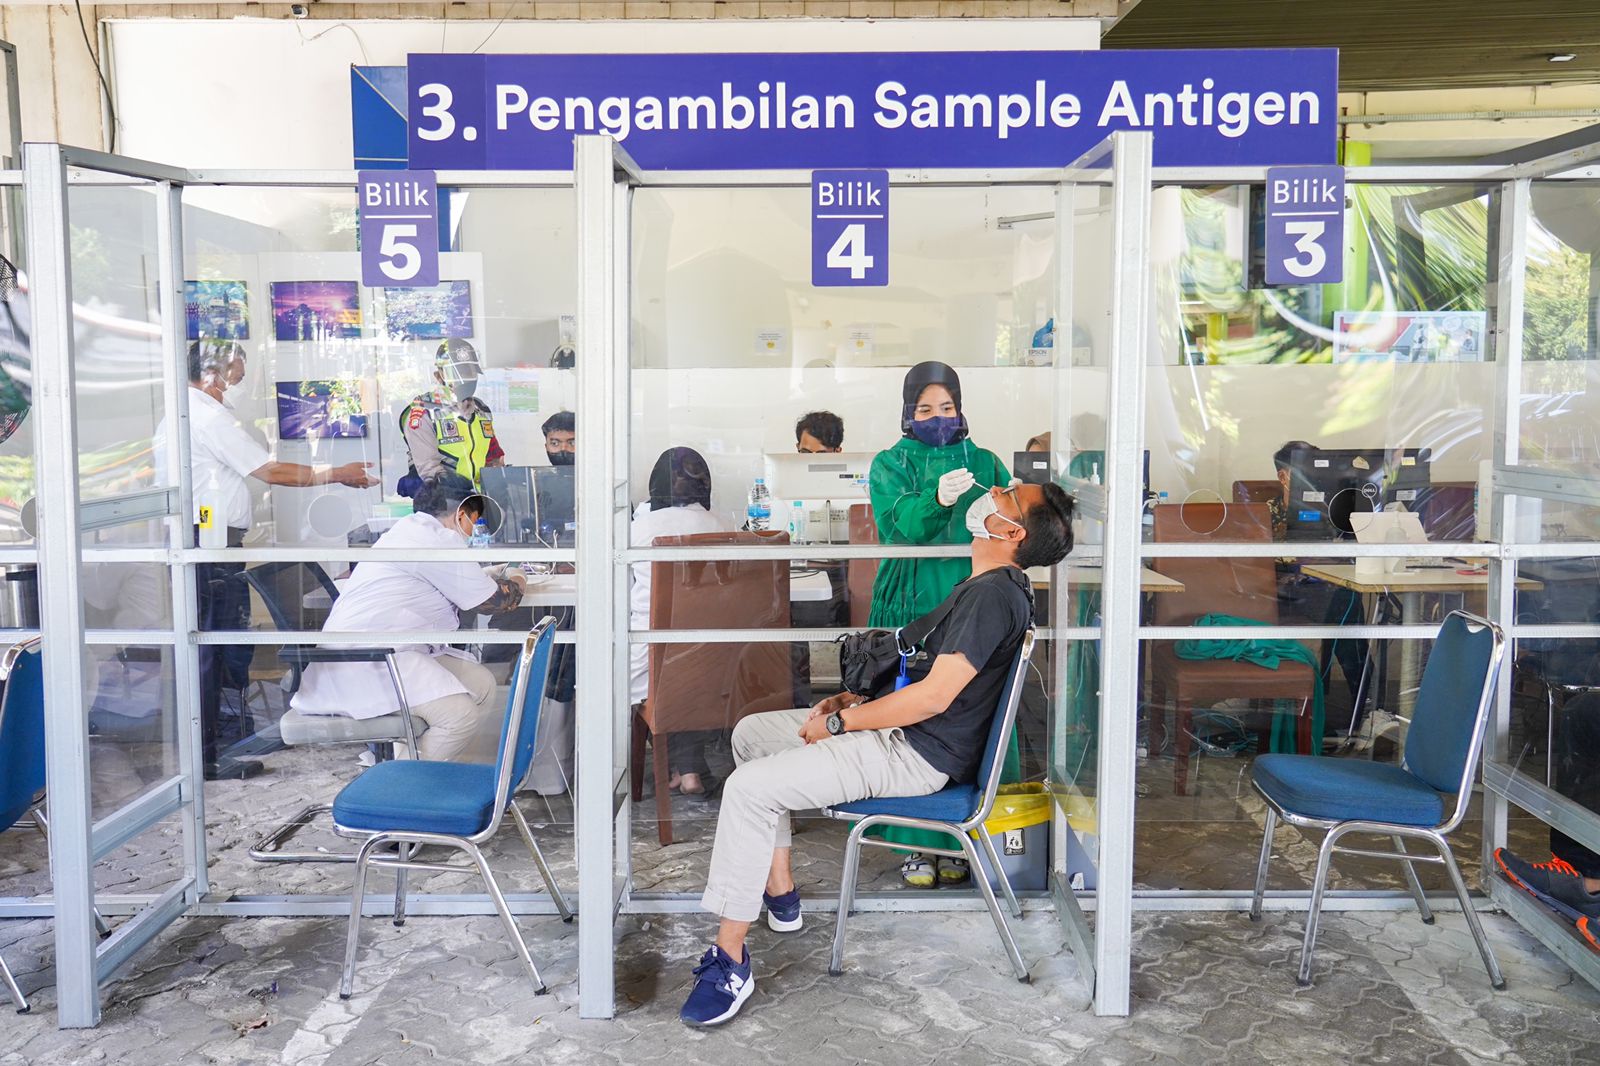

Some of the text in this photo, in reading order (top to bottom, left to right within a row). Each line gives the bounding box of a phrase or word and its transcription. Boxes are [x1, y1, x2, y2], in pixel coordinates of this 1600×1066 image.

[418, 77, 1320, 142] 3. Pengambilan Sample Antigen
[364, 181, 430, 207] Bilik
[818, 181, 881, 206] Bilik
[1273, 178, 1337, 204] Bilik
[377, 223, 422, 282] 5
[826, 223, 874, 280] 4
[1282, 220, 1327, 278] 3
